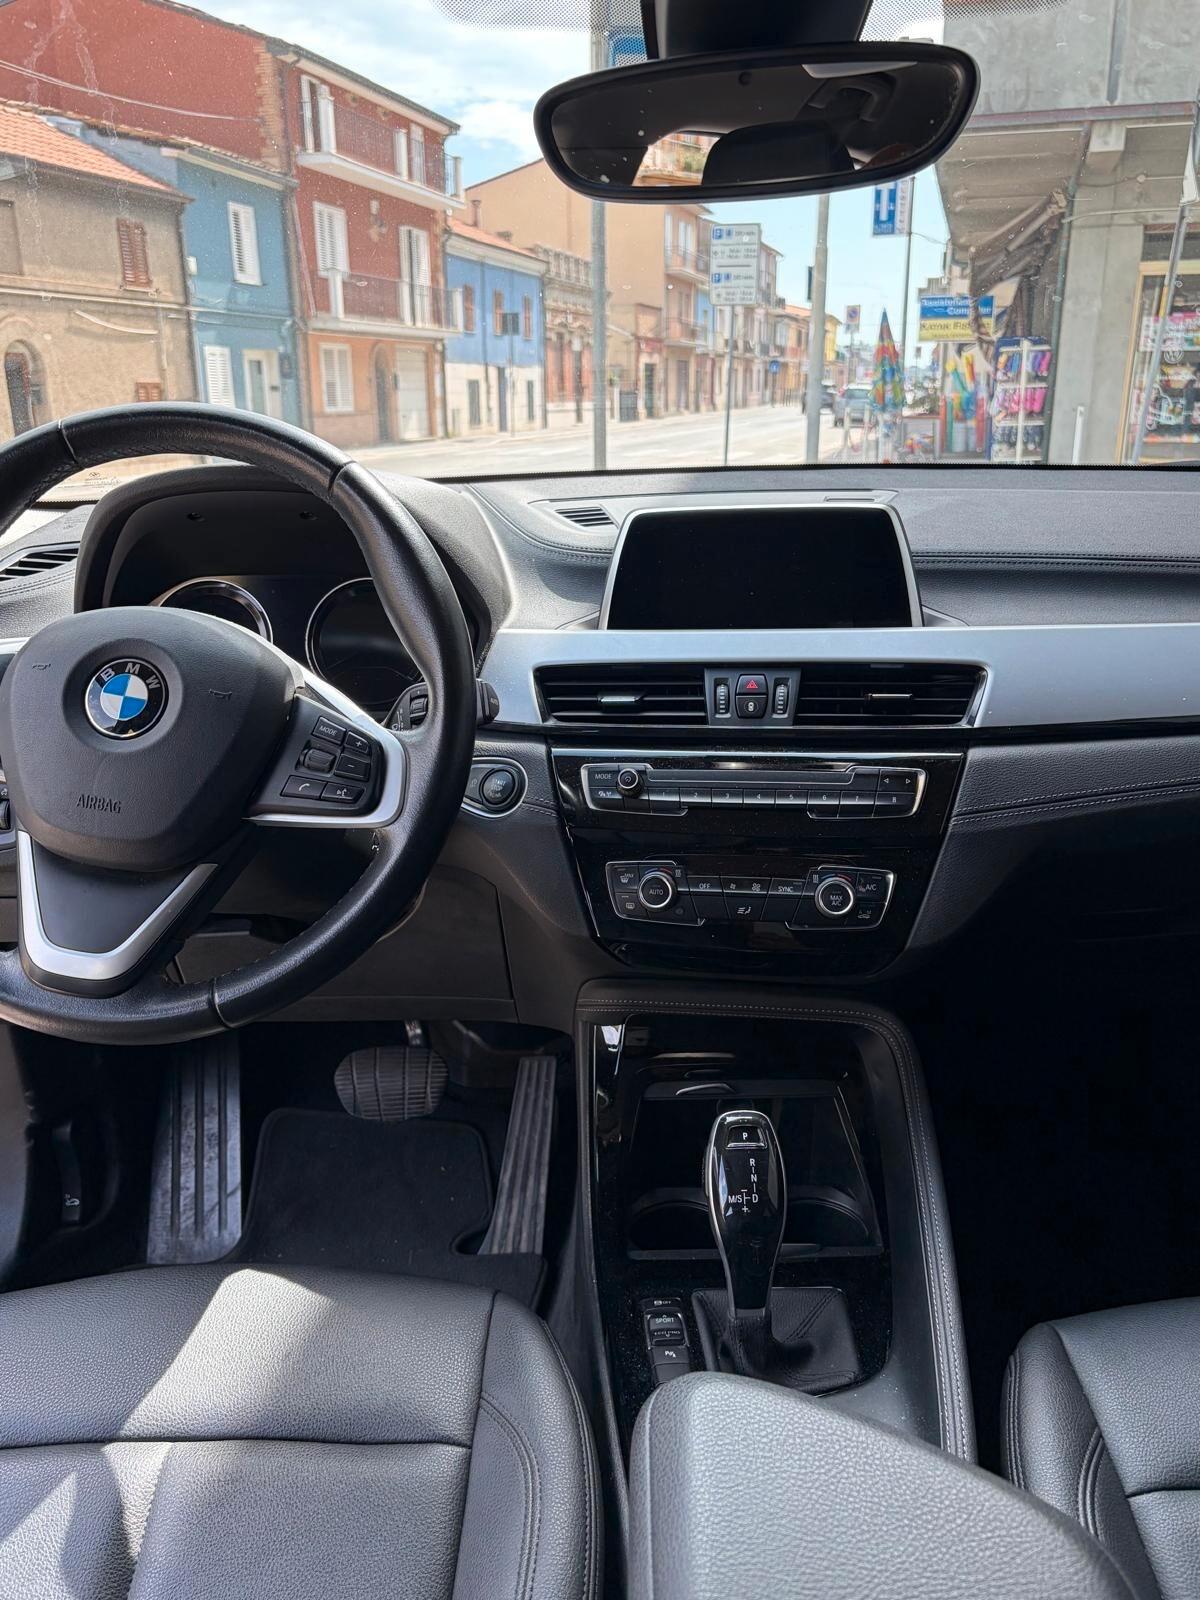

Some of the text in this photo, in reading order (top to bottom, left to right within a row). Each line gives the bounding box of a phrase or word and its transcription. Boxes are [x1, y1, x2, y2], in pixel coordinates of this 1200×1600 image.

[100, 662, 161, 690] BMW
[319, 725, 338, 736] MODE
[76, 794, 121, 814] AIRBAG
[742, 1132, 748, 1140] P
[749, 1158, 756, 1167] R
[750, 1174, 758, 1182] N
[728, 1195, 742, 1203] M/S
[752, 1194, 759, 1203] D
